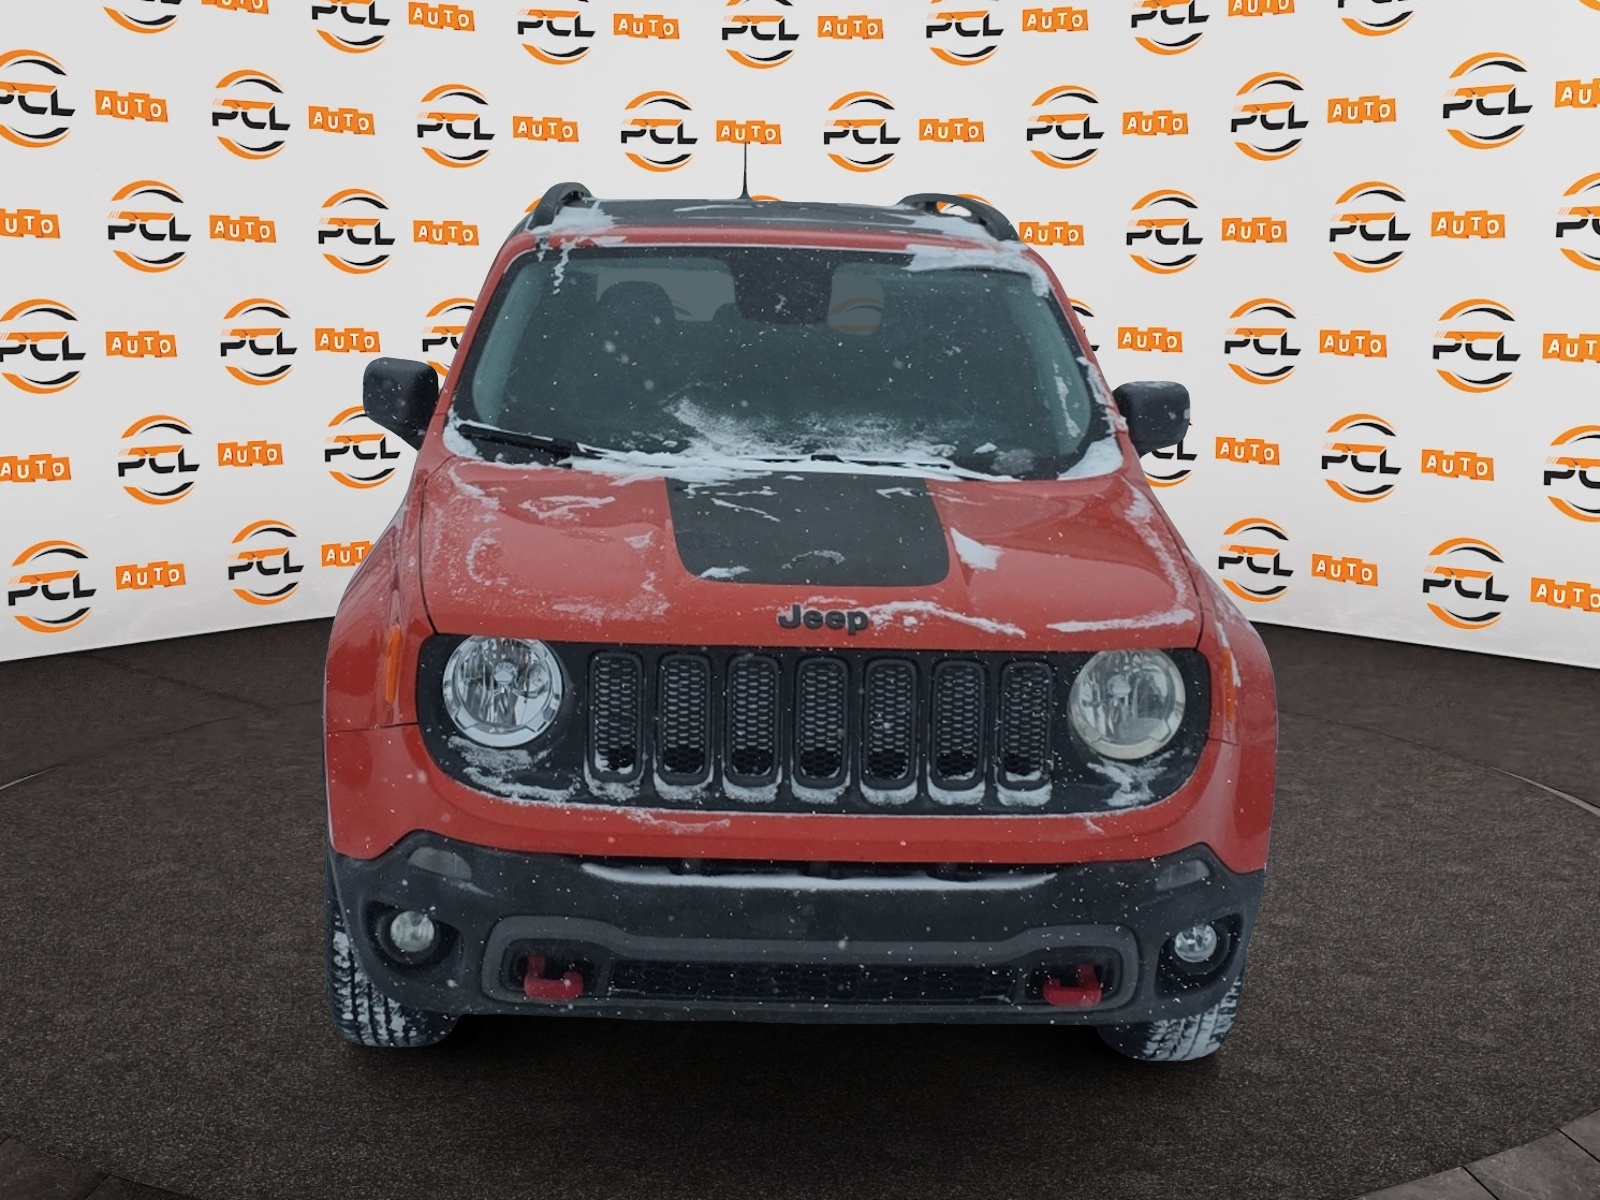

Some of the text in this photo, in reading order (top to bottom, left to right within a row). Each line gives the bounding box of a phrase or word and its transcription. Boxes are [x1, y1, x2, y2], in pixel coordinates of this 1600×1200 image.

[413, 7, 469, 27] AUTO
[518, 10, 674, 37] PCL AUTO
[722, 16, 878, 40] PCL AUTO
[927, 11, 1083, 38] PCL AUTO
[101, 96, 162, 117] AUTO
[213, 100, 369, 130] PCL AUTO
[1443, 85, 1532, 118] PCL
[418, 113, 573, 140] PCL AUTO
[1027, 114, 1183, 141] PCL AUTO
[1231, 102, 1390, 132] PCL AUTO
[621, 119, 776, 144] PCL AUTO
[824, 119, 979, 144] PCL AUTO
[5, 215, 53, 234] UTO
[108, 212, 270, 241] PCL AUTO
[319, 218, 473, 245] PCL AUTO
[1024, 226, 1079, 242] AUTO
[1127, 219, 1282, 245] PCL AUTO
[1330, 213, 1499, 241] PCL AUTO
[0, 332, 171, 362] PCL AUTO
[221, 328, 375, 356] PCL AUTO
[1123, 332, 1177, 348] AUTO
[1225, 328, 1381, 355] PCL AUTO
[1433, 332, 1597, 361] PCL AUT
[118, 445, 277, 476] PCL AUTO
[325, 434, 400, 462] PCL
[1220, 442, 1274, 461] AUTO
[1322, 443, 1488, 476] PCL AUTO
[0, 460, 64, 479] AUTO
[1544, 457, 1600, 489] PC
[229, 547, 365, 580] PCL AUT
[1219, 545, 1372, 581] PCL AUTO
[8, 567, 179, 606] PCL AUTO
[1423, 567, 1509, 602] PCL
[778, 604, 869, 635] Jeep
